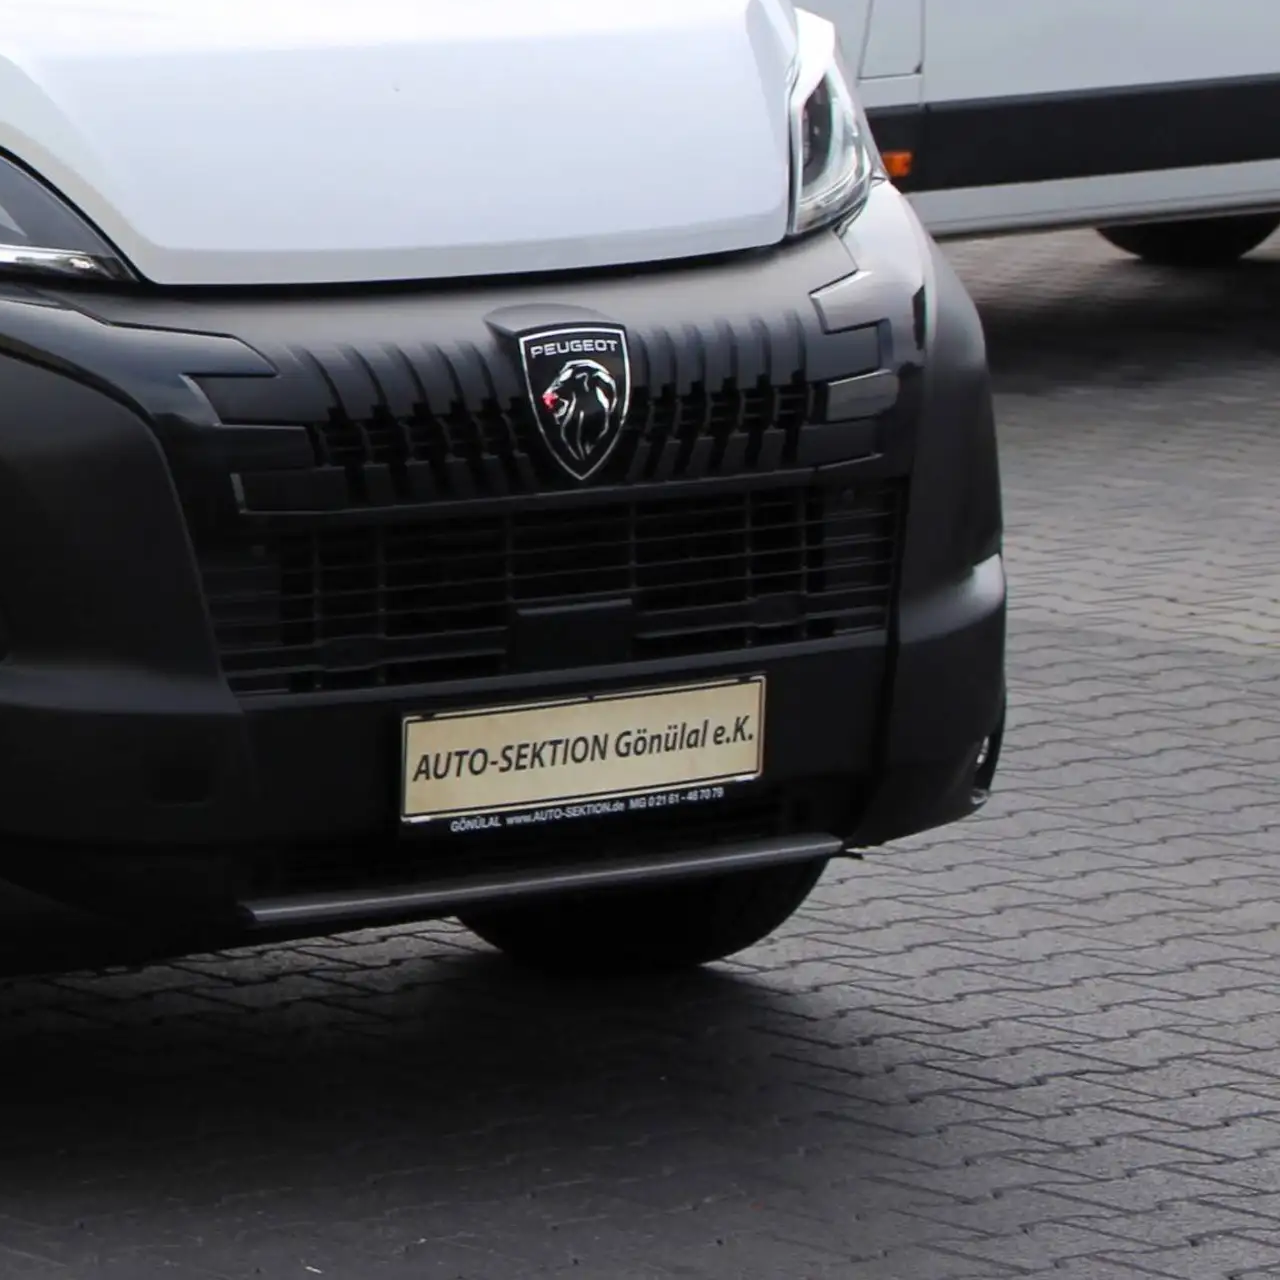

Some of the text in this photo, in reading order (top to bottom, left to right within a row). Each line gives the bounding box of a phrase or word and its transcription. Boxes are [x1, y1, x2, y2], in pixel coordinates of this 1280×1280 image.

[530, 338, 618, 360] PEUGEOT
[412, 715, 755, 782] AUTO-SEKTION Gönülal e.K.
[450, 815, 502, 832] GÖNÜLAL
[505, 801, 625, 825] www.AUTO-SEKTION.de
